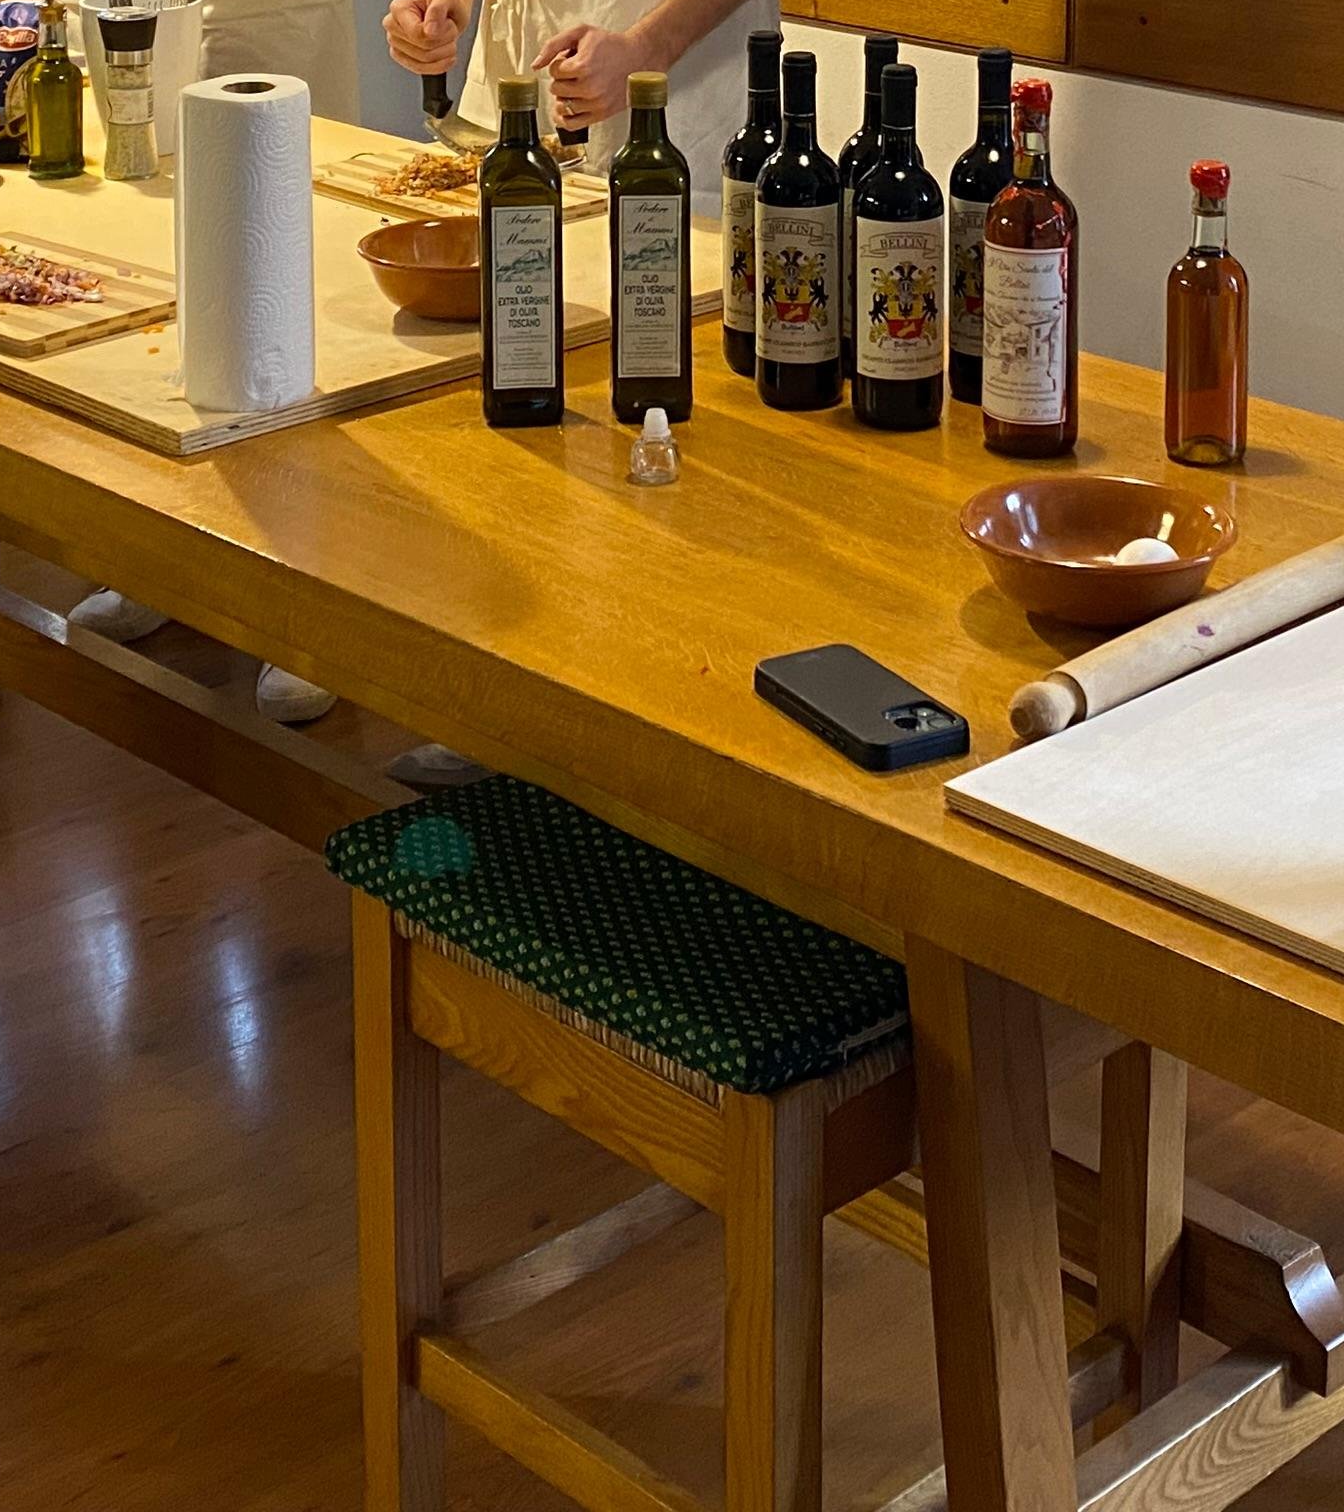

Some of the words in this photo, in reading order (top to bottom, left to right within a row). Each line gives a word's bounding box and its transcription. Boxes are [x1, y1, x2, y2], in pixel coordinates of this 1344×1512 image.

[767, 222, 814, 237] BELLINI
[879, 236, 929, 249] BELLINI
[641, 274, 659, 284] OLIO
[515, 285, 533, 295] OLIO
[624, 285, 645, 296] EXTRA
[646, 285, 676, 295] VERGINE
[498, 297, 519, 307] EXTRA
[521, 296, 550, 306] VERGINE
[636, 296, 643, 306] DI
[644, 296, 665, 306] OLIVA
[510, 308, 517, 318] DI
[518, 308, 538, 317] OLIVA
[634, 307, 666, 317] TOSCANO
[508, 319, 541, 329] TOSCANO
